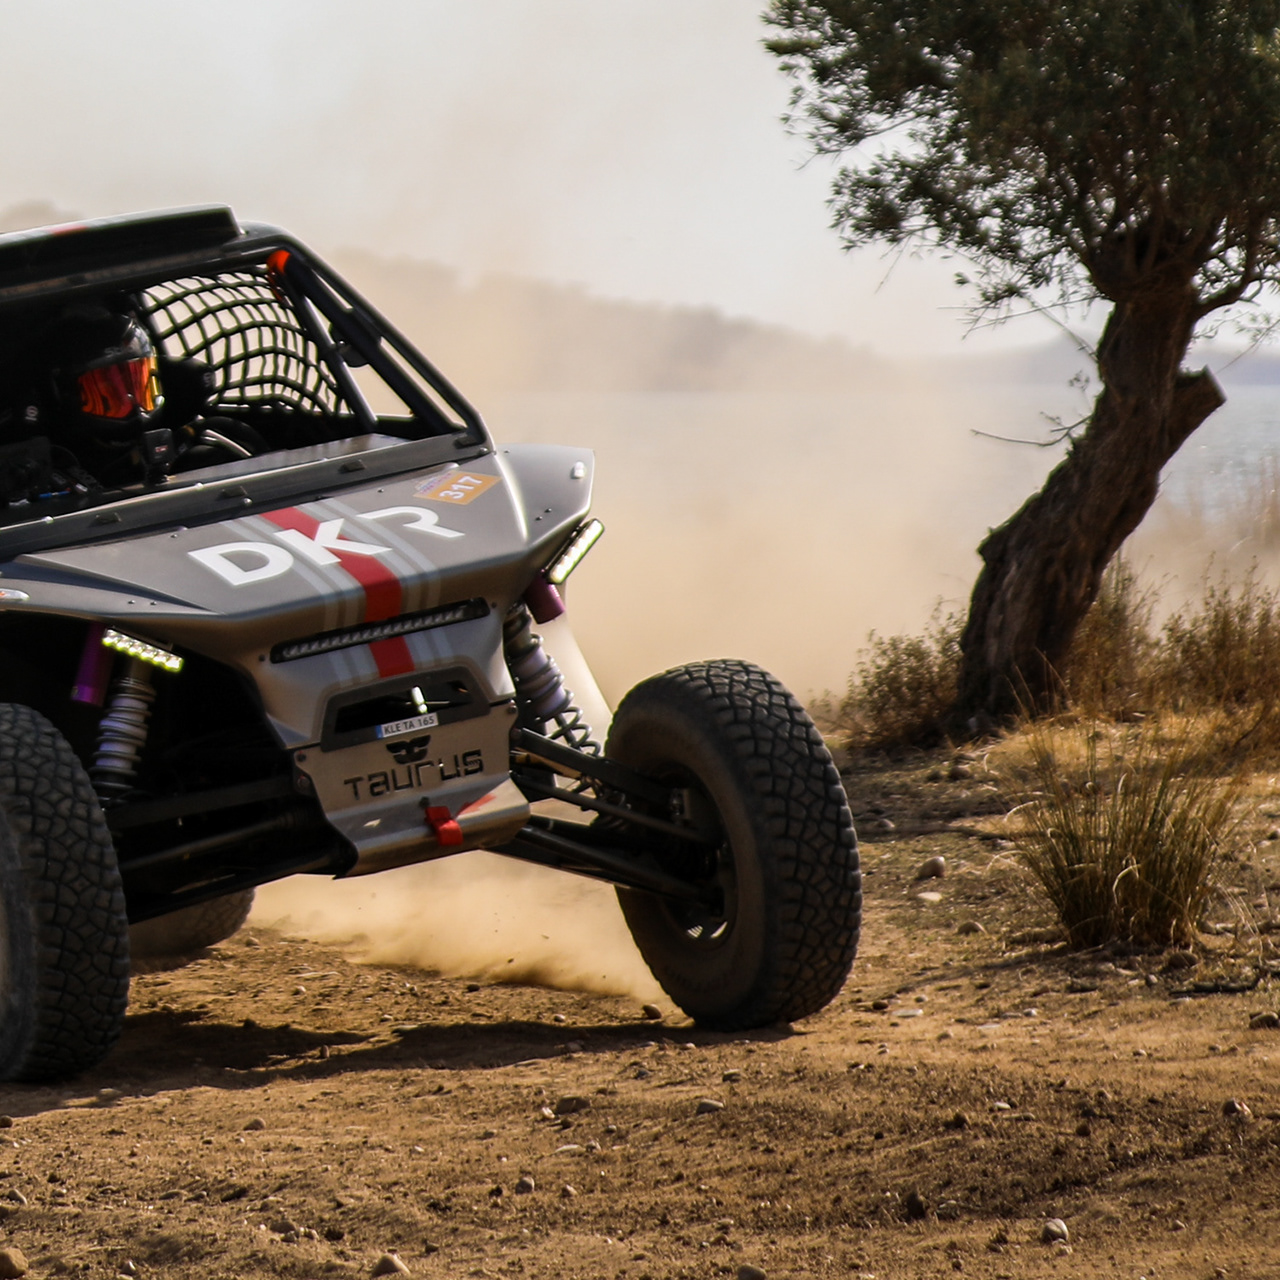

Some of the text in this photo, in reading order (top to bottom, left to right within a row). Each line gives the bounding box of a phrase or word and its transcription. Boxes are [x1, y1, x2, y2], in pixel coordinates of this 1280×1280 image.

[439, 475, 483, 499] 317
[187, 506, 466, 586] DKR
[384, 715, 435, 735] KLE TA 165
